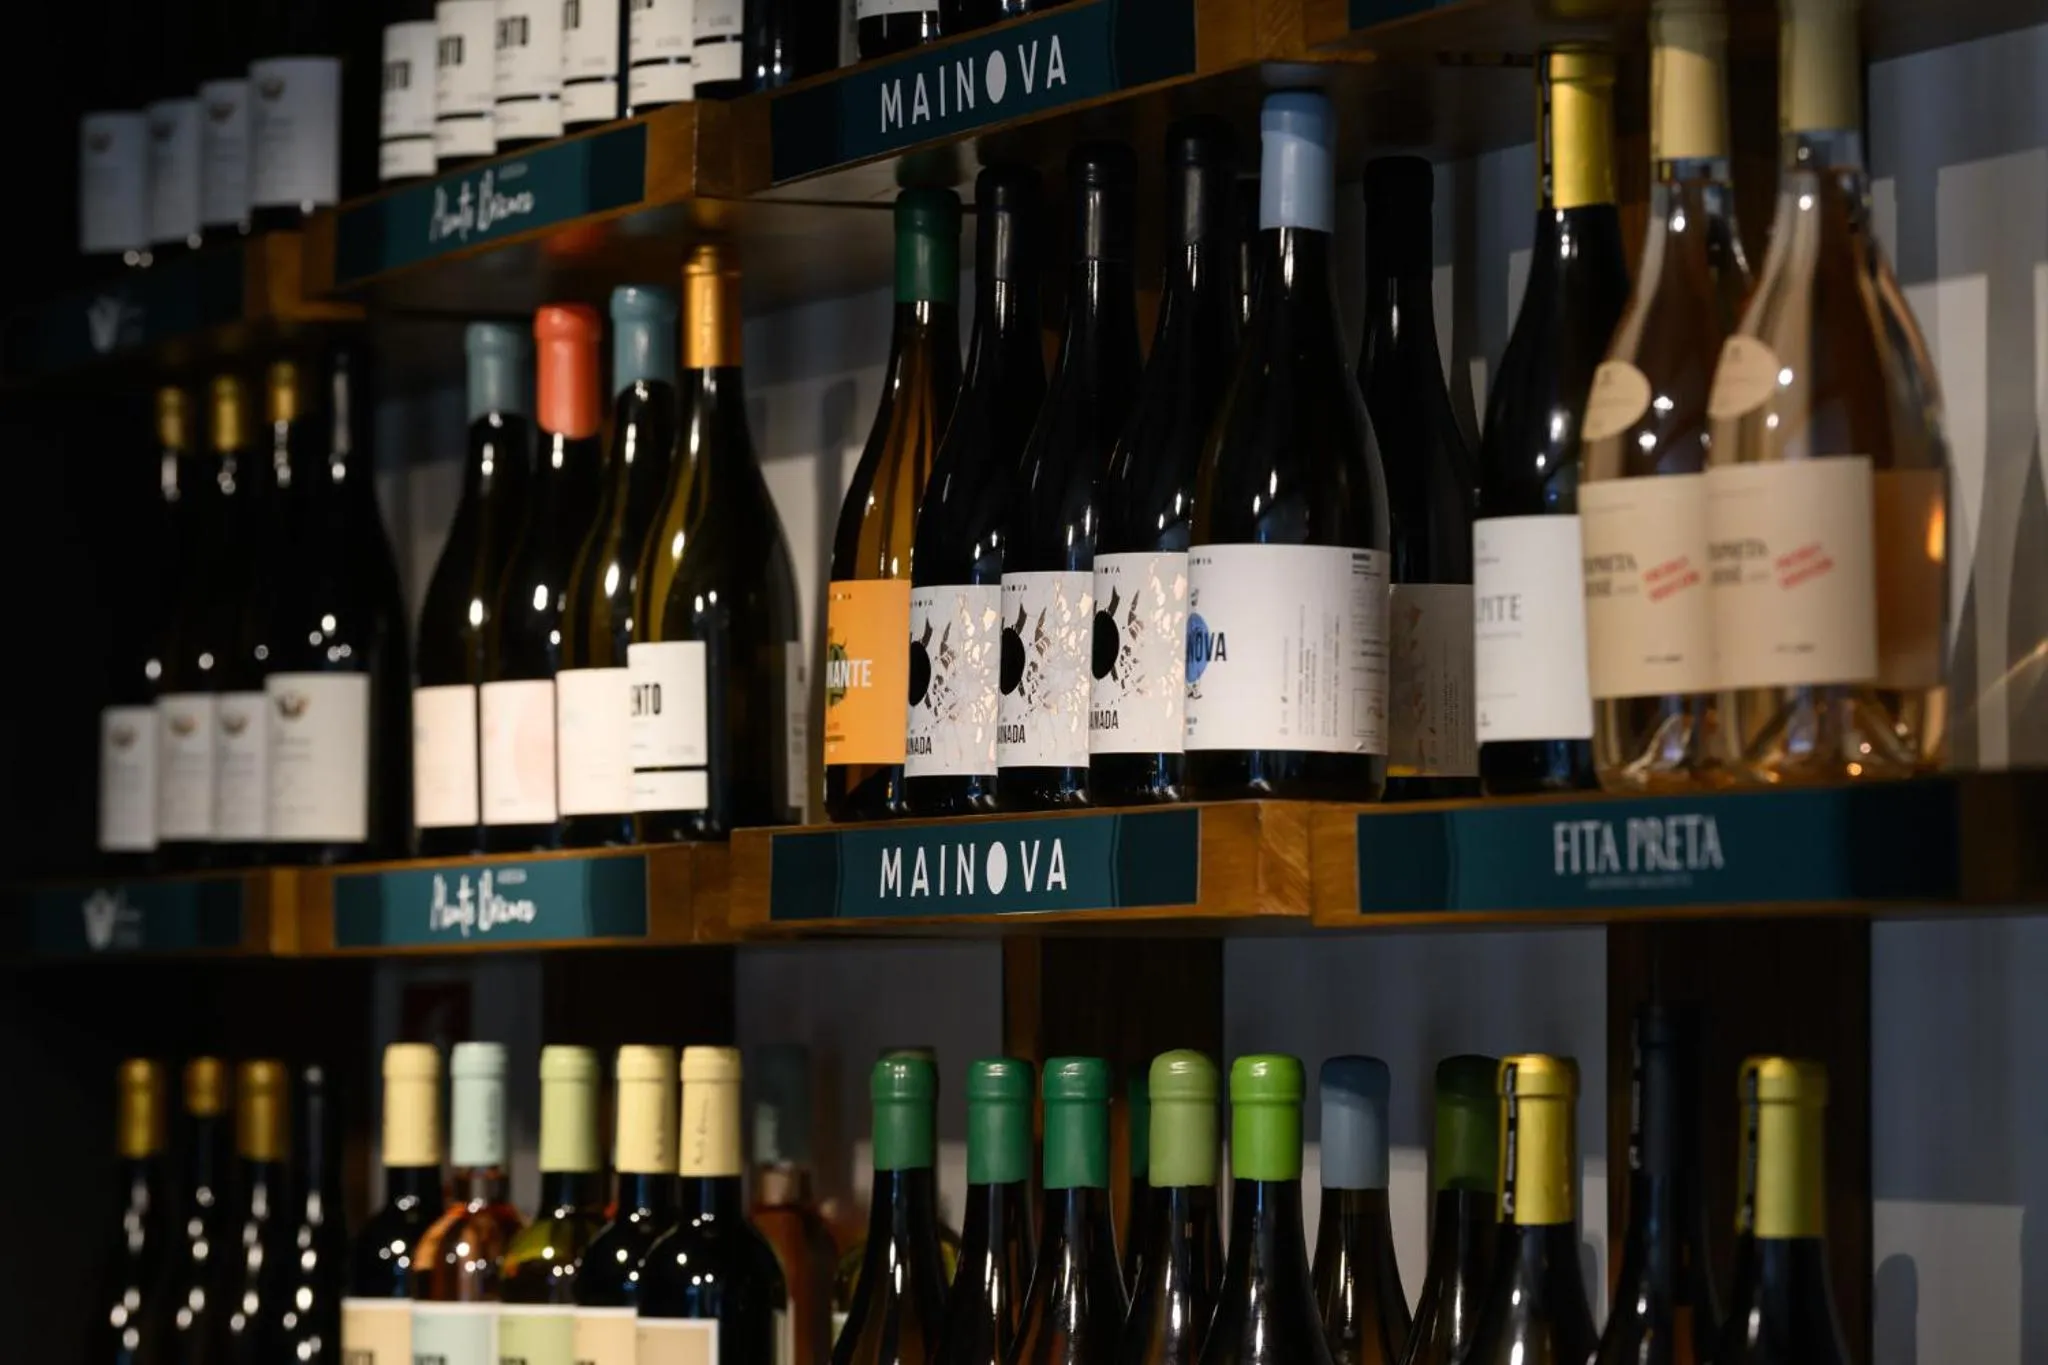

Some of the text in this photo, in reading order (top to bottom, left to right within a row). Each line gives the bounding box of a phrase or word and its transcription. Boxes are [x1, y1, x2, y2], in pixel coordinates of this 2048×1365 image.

[880, 34, 1067, 133] MAINOVA
[879, 838, 1067, 898] MAINOVA
[1553, 812, 1725, 875] FITA PRETA
